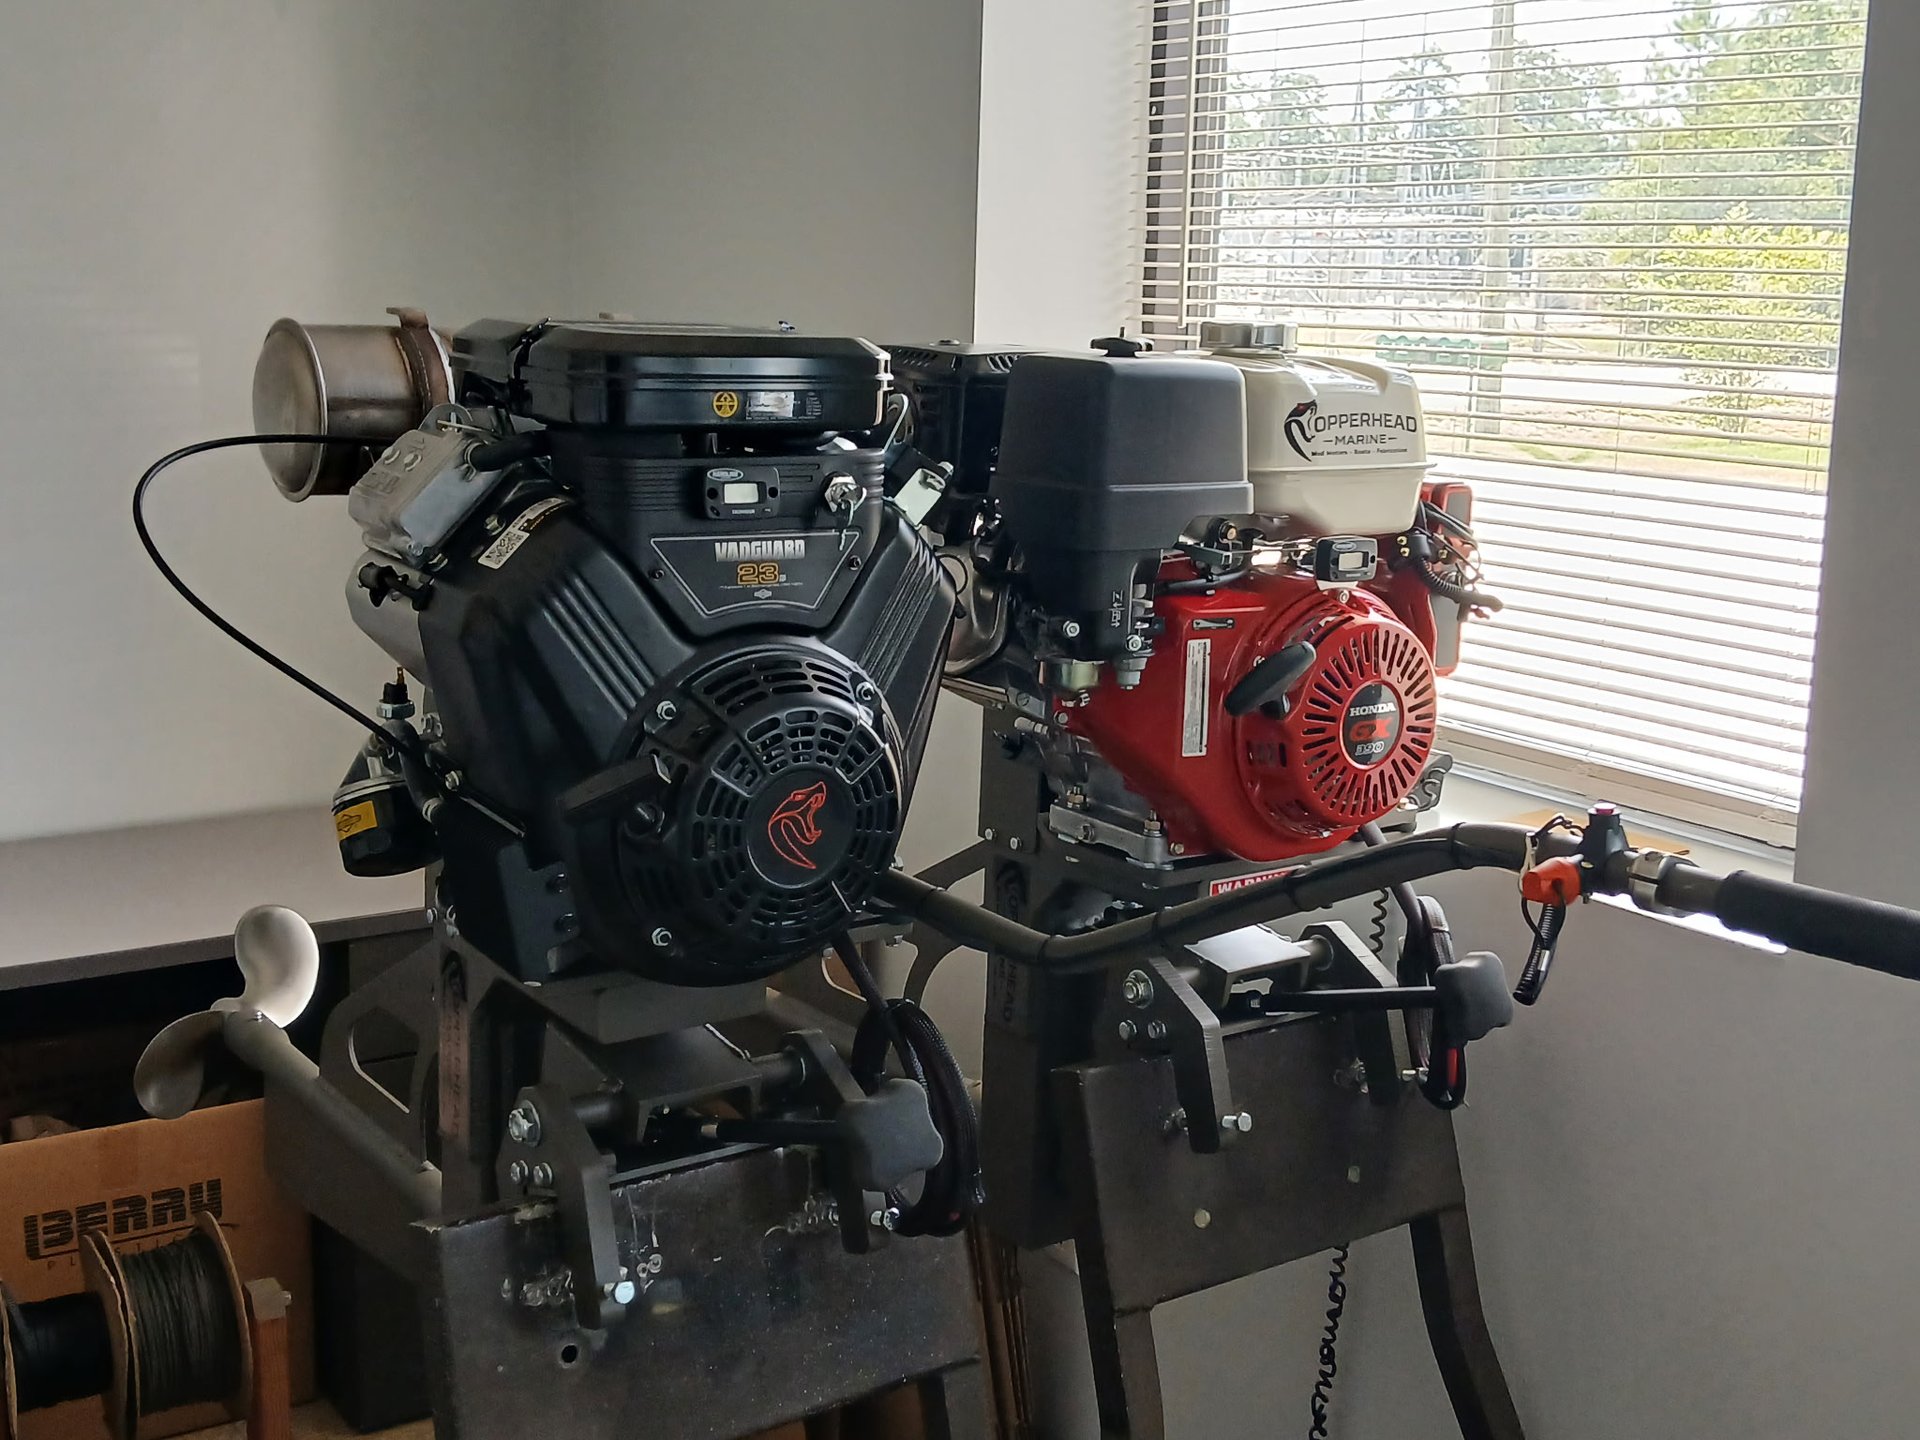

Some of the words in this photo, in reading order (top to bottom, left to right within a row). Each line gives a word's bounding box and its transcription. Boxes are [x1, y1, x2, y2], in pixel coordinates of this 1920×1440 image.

[1334, 434, 1387, 445] MARINE
[715, 540, 805, 562] VANGUARD
[737, 562, 779, 585] 23
[1349, 702, 1397, 717] HONDA
[1350, 717, 1393, 741] GX
[1217, 871, 1287, 894] WARN
[23, 1178, 223, 1261] BERRY
